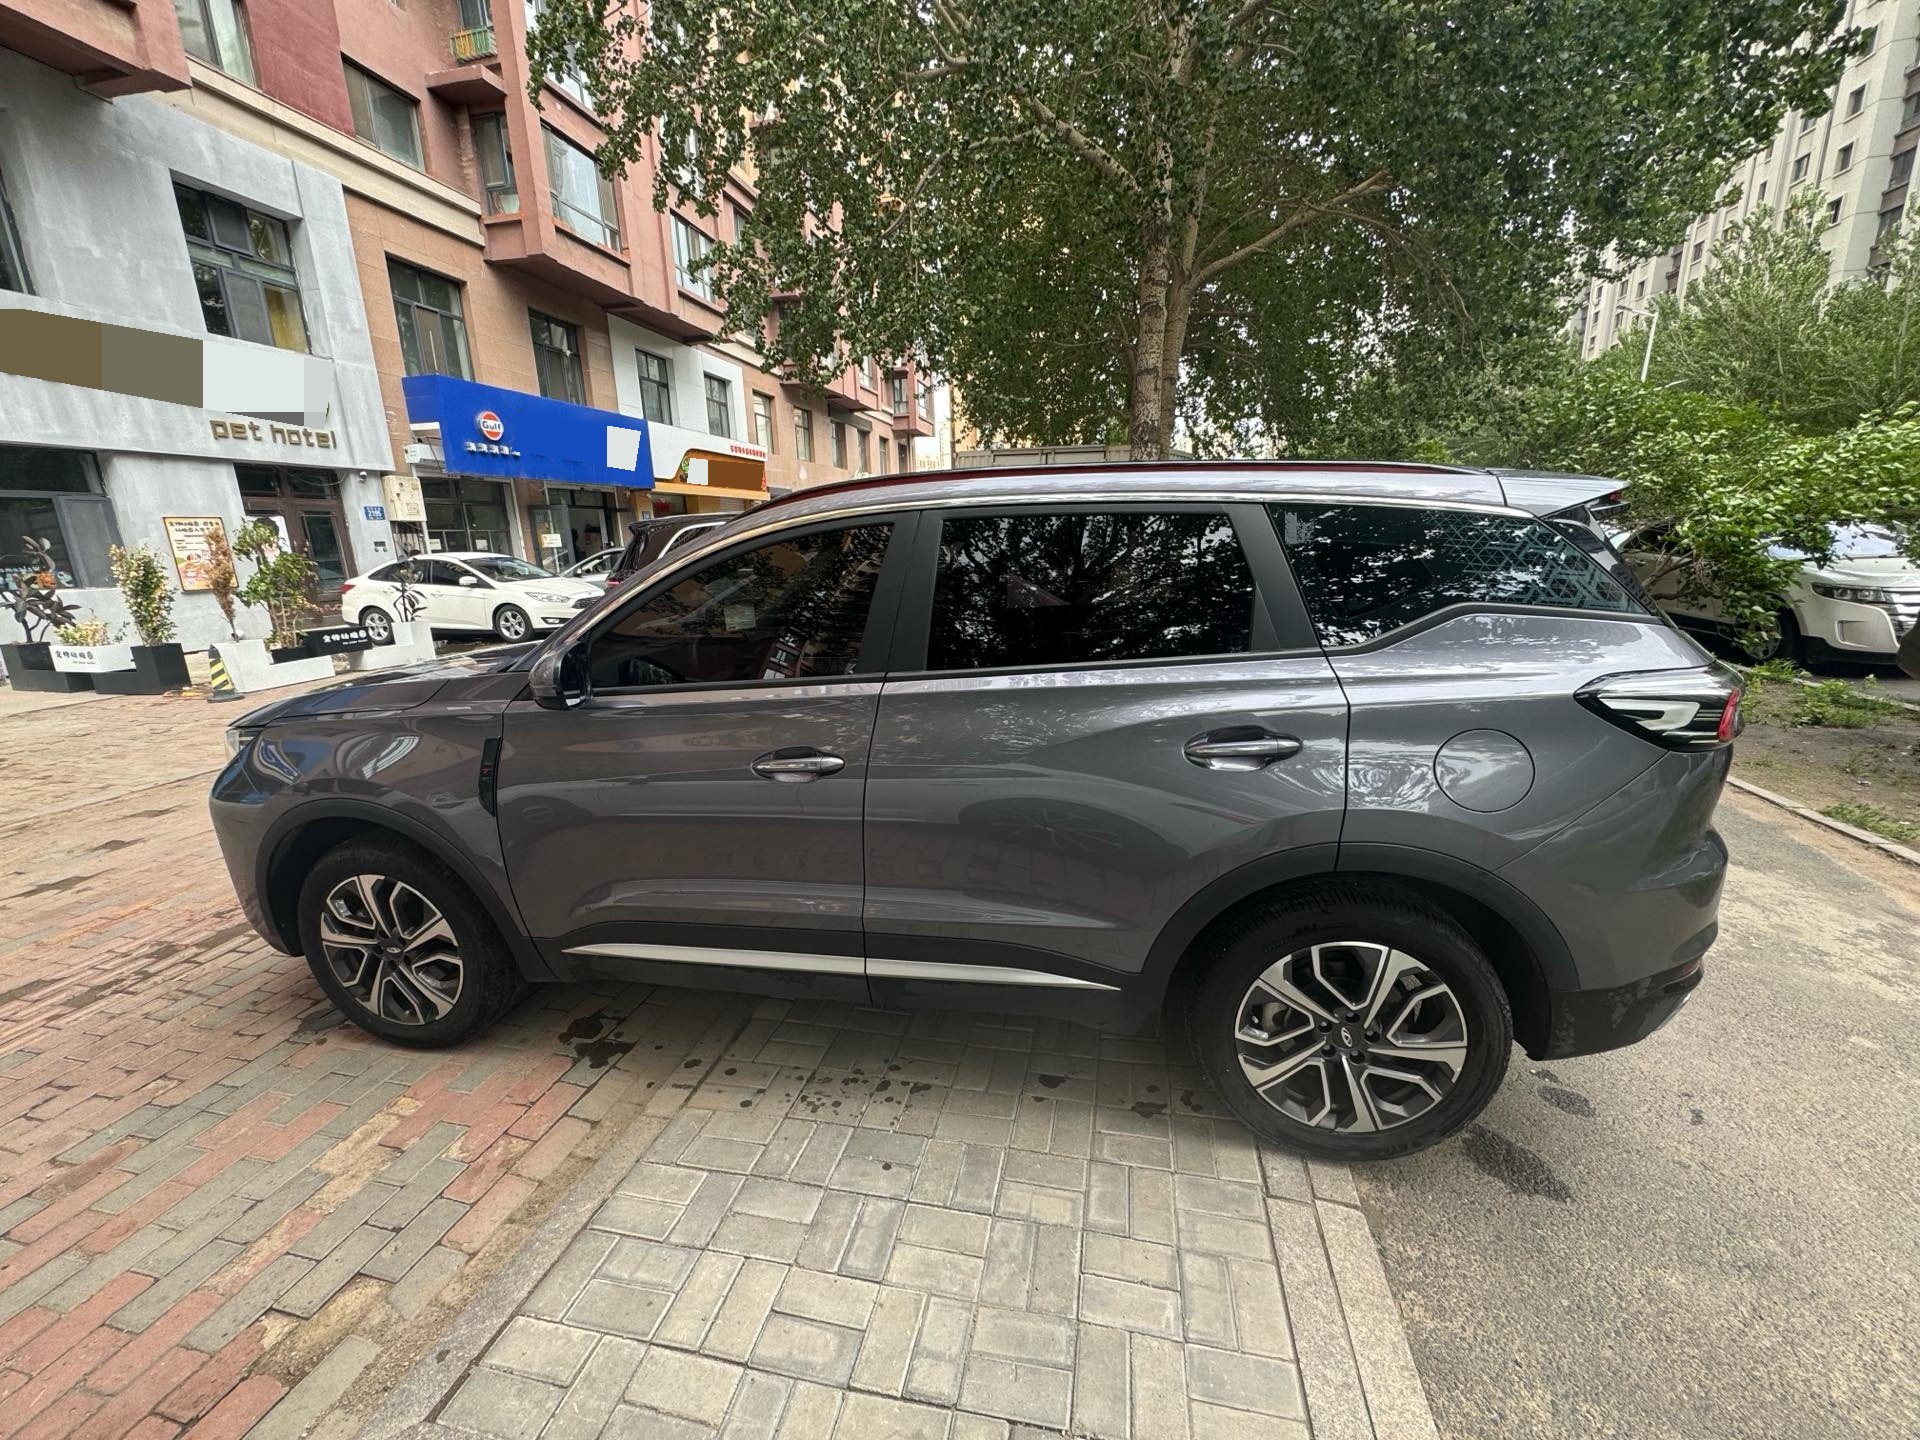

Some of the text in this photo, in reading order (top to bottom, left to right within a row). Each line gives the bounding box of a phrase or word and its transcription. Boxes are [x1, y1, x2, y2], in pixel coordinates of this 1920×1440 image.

[209, 420, 337, 449] pet hotel
[482, 420, 502, 430] Gulf
